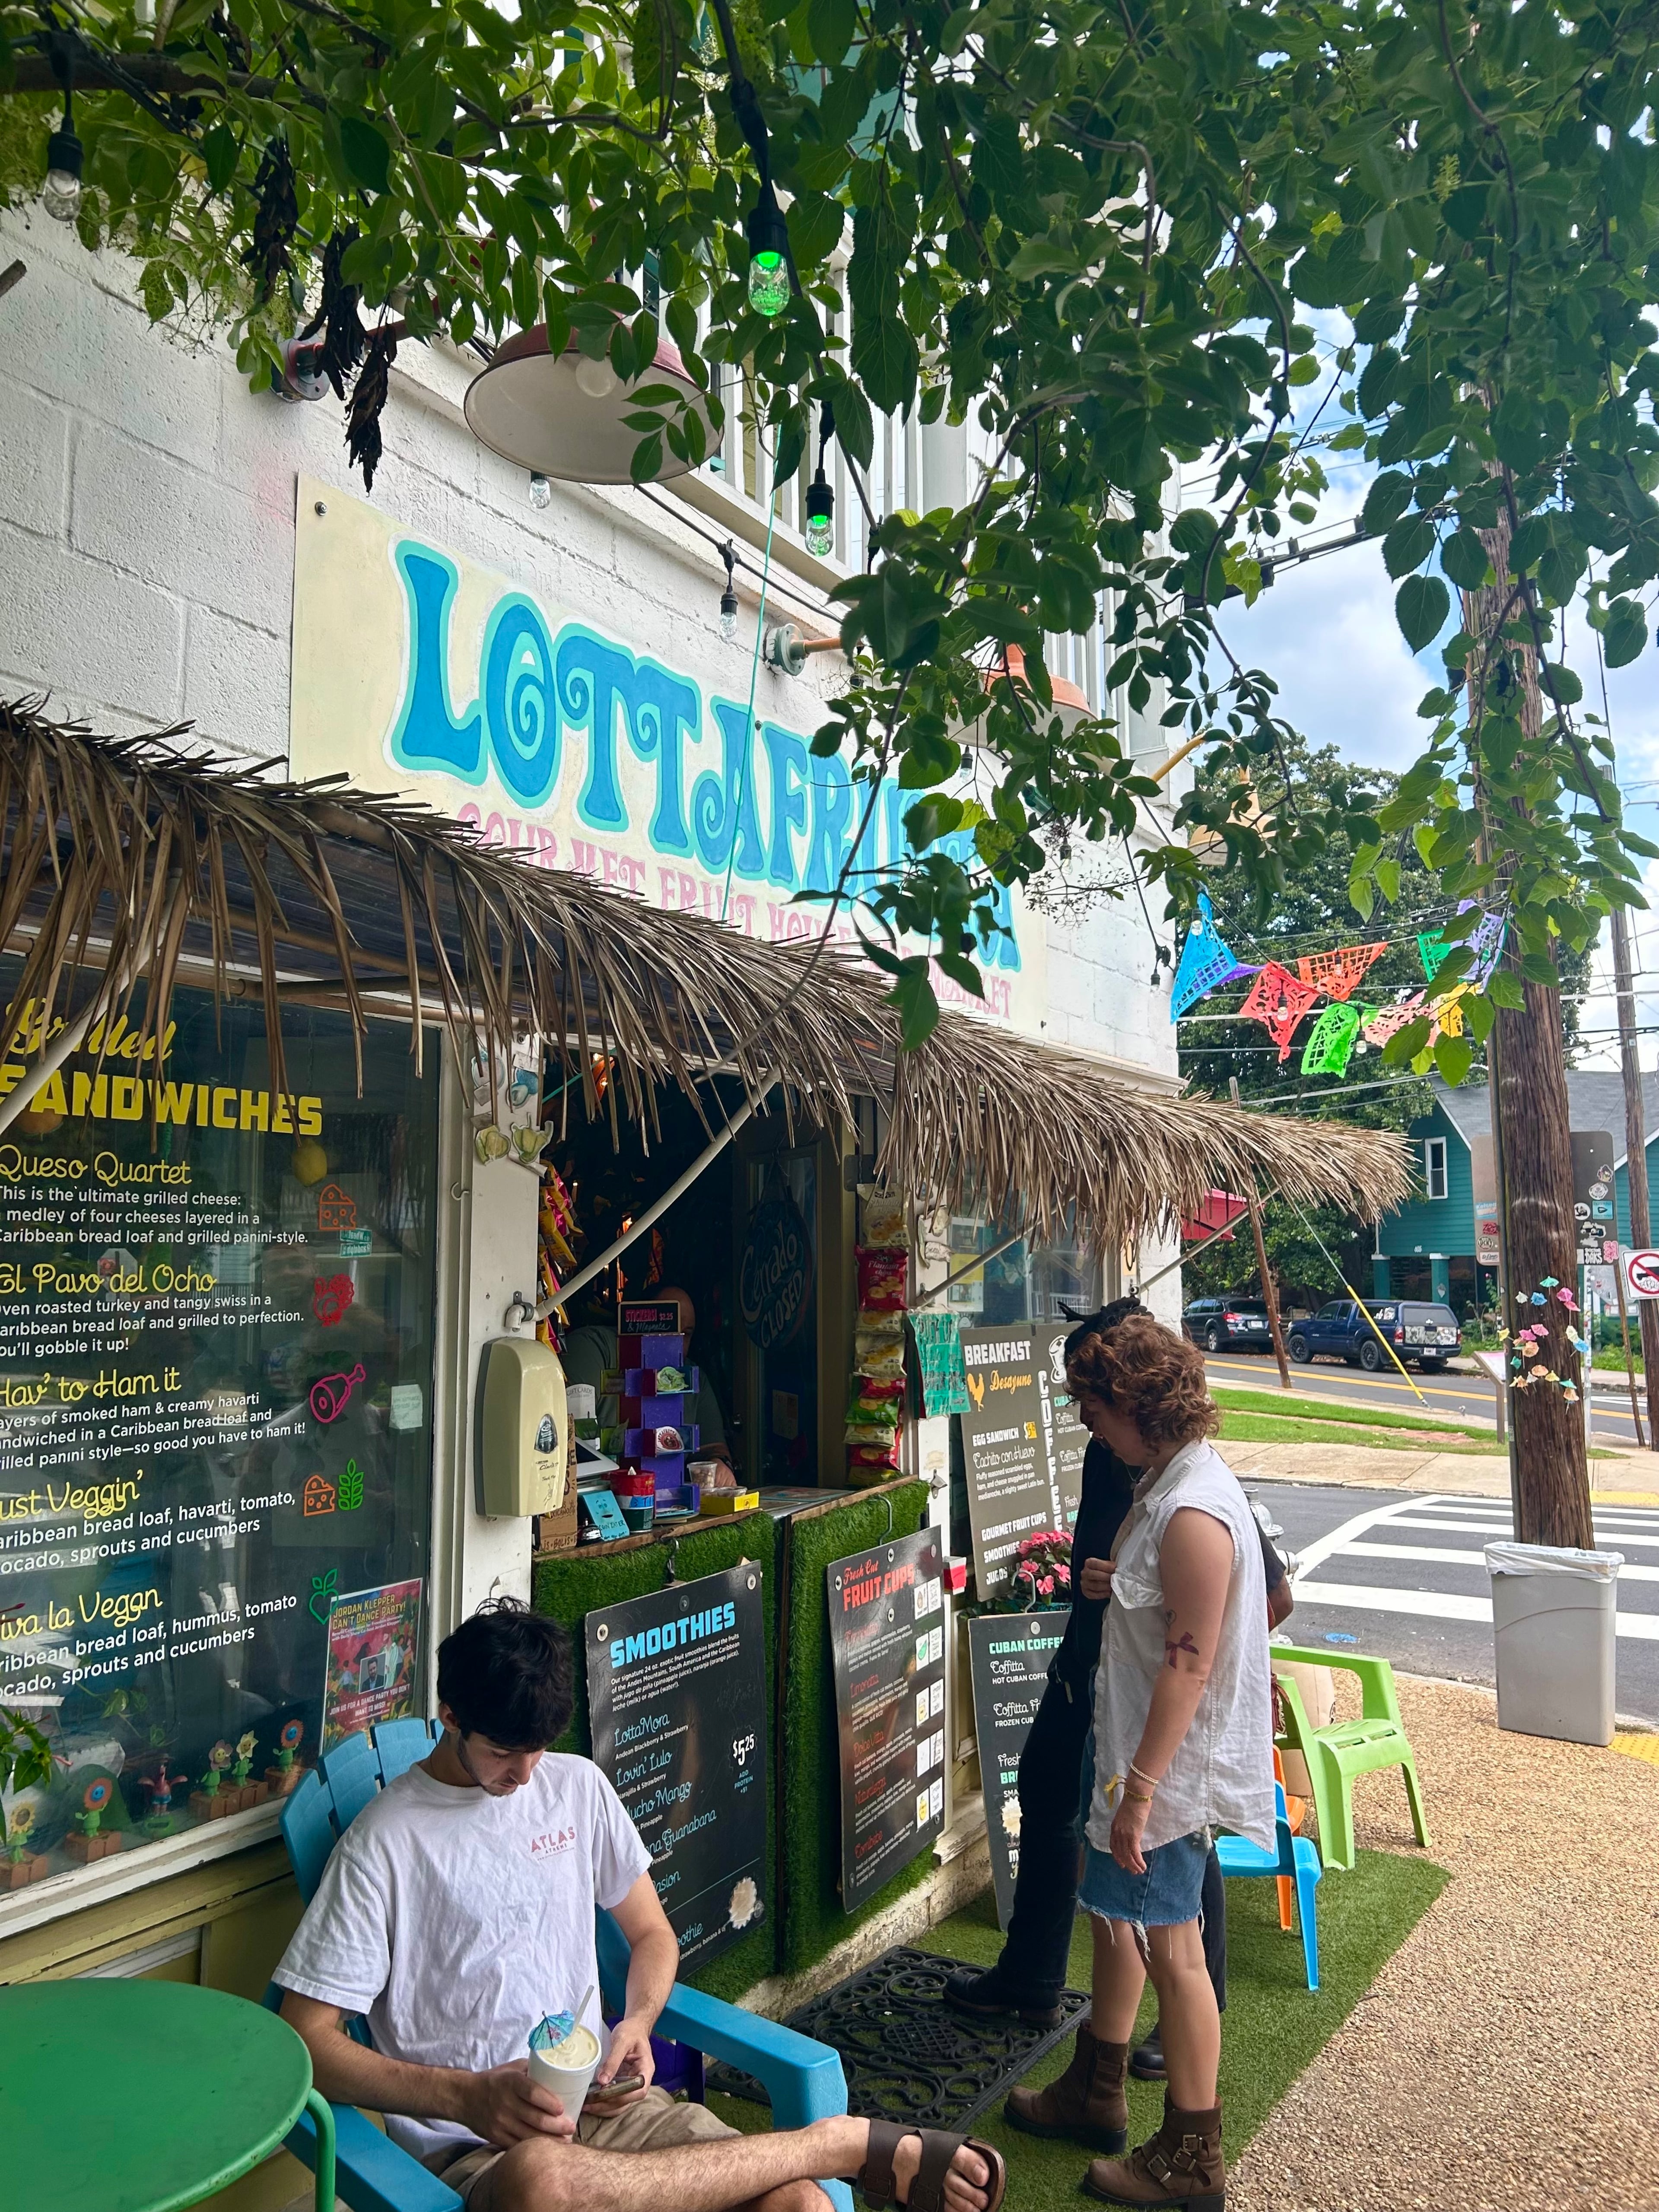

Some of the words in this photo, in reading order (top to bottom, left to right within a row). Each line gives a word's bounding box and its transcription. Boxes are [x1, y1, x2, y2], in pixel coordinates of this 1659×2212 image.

[390, 539, 1021, 972] LOTTAFRUA
[657, 865, 756, 936] FRUIT
[928, 956, 1011, 1019] MAKET
[6, 997, 176, 1061] Grlled
[0, 1144, 88, 1182] Queso
[95, 1151, 192, 1187] Quartet
[31, 1186, 43, 1200] is
[48, 1187, 74, 1201] the
[79, 1188, 140, 1203] ultimate
[143, 1190, 188, 1205] grilled
[192, 1192, 241, 1205] cheese:
[6, 1208, 65, 1224] medley
[70, 1209, 86, 1222] of
[90, 1209, 122, 1223] four
[125, 1210, 181, 1224] cheeses
[185, 1211, 234, 1224] layered
[237, 1212, 249, 1224] in
[252, 1215, 260, 1224] a
[79, 1229, 121, 1243] bread
[126, 1230, 154, 1243] loaf
[157, 1230, 183, 1243] and
[187, 1230, 230, 1245] grilled
[234, 1230, 308, 1245] panini-style.
[0, 1263, 26, 1293] El
[32, 1263, 105, 1293] Pavo
[109, 1265, 148, 1293] del
[152, 1264, 217, 1293] Ocho
[35, 1300, 92, 1315] roasted
[96, 1298, 140, 1313] turkey
[144, 1297, 169, 1310] and
[173, 1297, 212, 1310] tangy
[214, 1294, 246, 1307] swiss
[250, 1294, 261, 1306] in
[264, 1296, 271, 1305] a
[760, 1269, 803, 1348] CLOSED
[72, 1319, 115, 1333] bread
[119, 1317, 146, 1331] loaf
[149, 1316, 174, 1329] and
[178, 1313, 219, 1329] grilled
[222, 1314, 235, 1325] to
[239, 1310, 304, 1326] perfection.
[35, 1339, 88, 1357] gobble
[92, 1338, 102, 1351] it
[107, 1337, 129, 1352] up!
[964, 1340, 1031, 1366] BREAKFAST
[58, 1376, 89, 1402] to
[93, 1369, 160, 1398] Ham
[164, 1367, 182, 1392] it
[989, 1370, 1032, 1395] Desayuno
[41, 1411, 57, 1425] of
[61, 1405, 117, 1424] smoked
[121, 1404, 150, 1417] ham
[155, 1402, 164, 1414] &
[167, 1398, 214, 1413] creamy
[218, 1392, 259, 1408] havarti
[81, 1428, 94, 1441] in
[98, 1429, 106, 1440] a
[110, 1420, 179, 1438] Caribbean
[183, 1414, 220, 1430] bread
[223, 1411, 247, 1425] loaf
[249, 1408, 272, 1422] and
[972, 1433, 986, 1446] EGG
[987, 1427, 1019, 1444] SANDWICH
[39, 1447, 84, 1468] panini
[153, 1436, 188, 1454] good
[192, 1434, 215, 1449] you
[218, 1430, 247, 1443] have
[250, 1428, 263, 1440] to
[266, 1425, 291, 1438] ham
[294, 1422, 305, 1434] it!
[973, 1451, 1000, 1469] Cachito
[1001, 1451, 1014, 1463] con
[47, 1469, 143, 1519] Veggin'
[83, 1513, 134, 1536] bread
[139, 1507, 173, 1527] loaf,
[178, 1498, 235, 1522] havarti,
[240, 1491, 296, 1511] tomato,
[981, 1521, 1012, 1541] GOURMET
[1013, 1515, 1030, 1533] FRUIT
[1030, 1512, 1047, 1526] CUPS
[70, 1538, 136, 1564] sprouts
[140, 1530, 172, 1550] and
[176, 1519, 261, 1544] cucumbers
[983, 1541, 1020, 1564] SMOOTHIES
[843, 1564, 864, 1586] Fresh
[843, 1576, 882, 1612] FRUIT
[884, 1563, 915, 1595] CUPS
[986, 1567, 1008, 1585] JUGOS
[48, 1600, 75, 1630] la
[78, 1588, 164, 1628] Vegan
[333, 1602, 362, 1619] JORDAN
[364, 1594, 395, 1610] KLEPPER
[333, 1616, 355, 1630] CAN'T
[356, 1609, 380, 1624] DANCE
[381, 1601, 406, 1617] PARTY!
[75, 1630, 127, 1657] bread
[132, 1621, 167, 1643] loaf,
[172, 1609, 241, 1634] hummus,
[245, 1595, 297, 1618] tomato
[610, 1601, 735, 1669] SMOOTHIES
[62, 1656, 129, 1685] sprouts
[134, 1644, 165, 1667] and
[170, 1627, 255, 1658] cucumbers
[988, 1640, 1025, 1654] CUBAN
[990, 1659, 1025, 1675] Coffitta
[1006, 1674, 1028, 1684] CUBAN
[330, 1706, 340, 1716] JOIN
[347, 1701, 356, 1710] FOR
[361, 1696, 375, 1705] DANCE
[375, 1690, 390, 1700] PARTY
[355, 1708, 368, 1717] WANT
[993, 1702, 1029, 1717] Coffitta
[995, 1718, 1020, 1728] FROZEN
[615, 1747, 634, 1761] Andean
[634, 1737, 660, 1752] Blackberry
[664, 1724, 689, 1739] Strawberry
[649, 1749, 673, 1771] Lulo
[641, 1773, 667, 1789] Strawberry
[734, 1775, 753, 1789] PROTEIN
[655, 1781, 692, 1808] Mango
[531, 1826, 575, 1853] ATLAS
